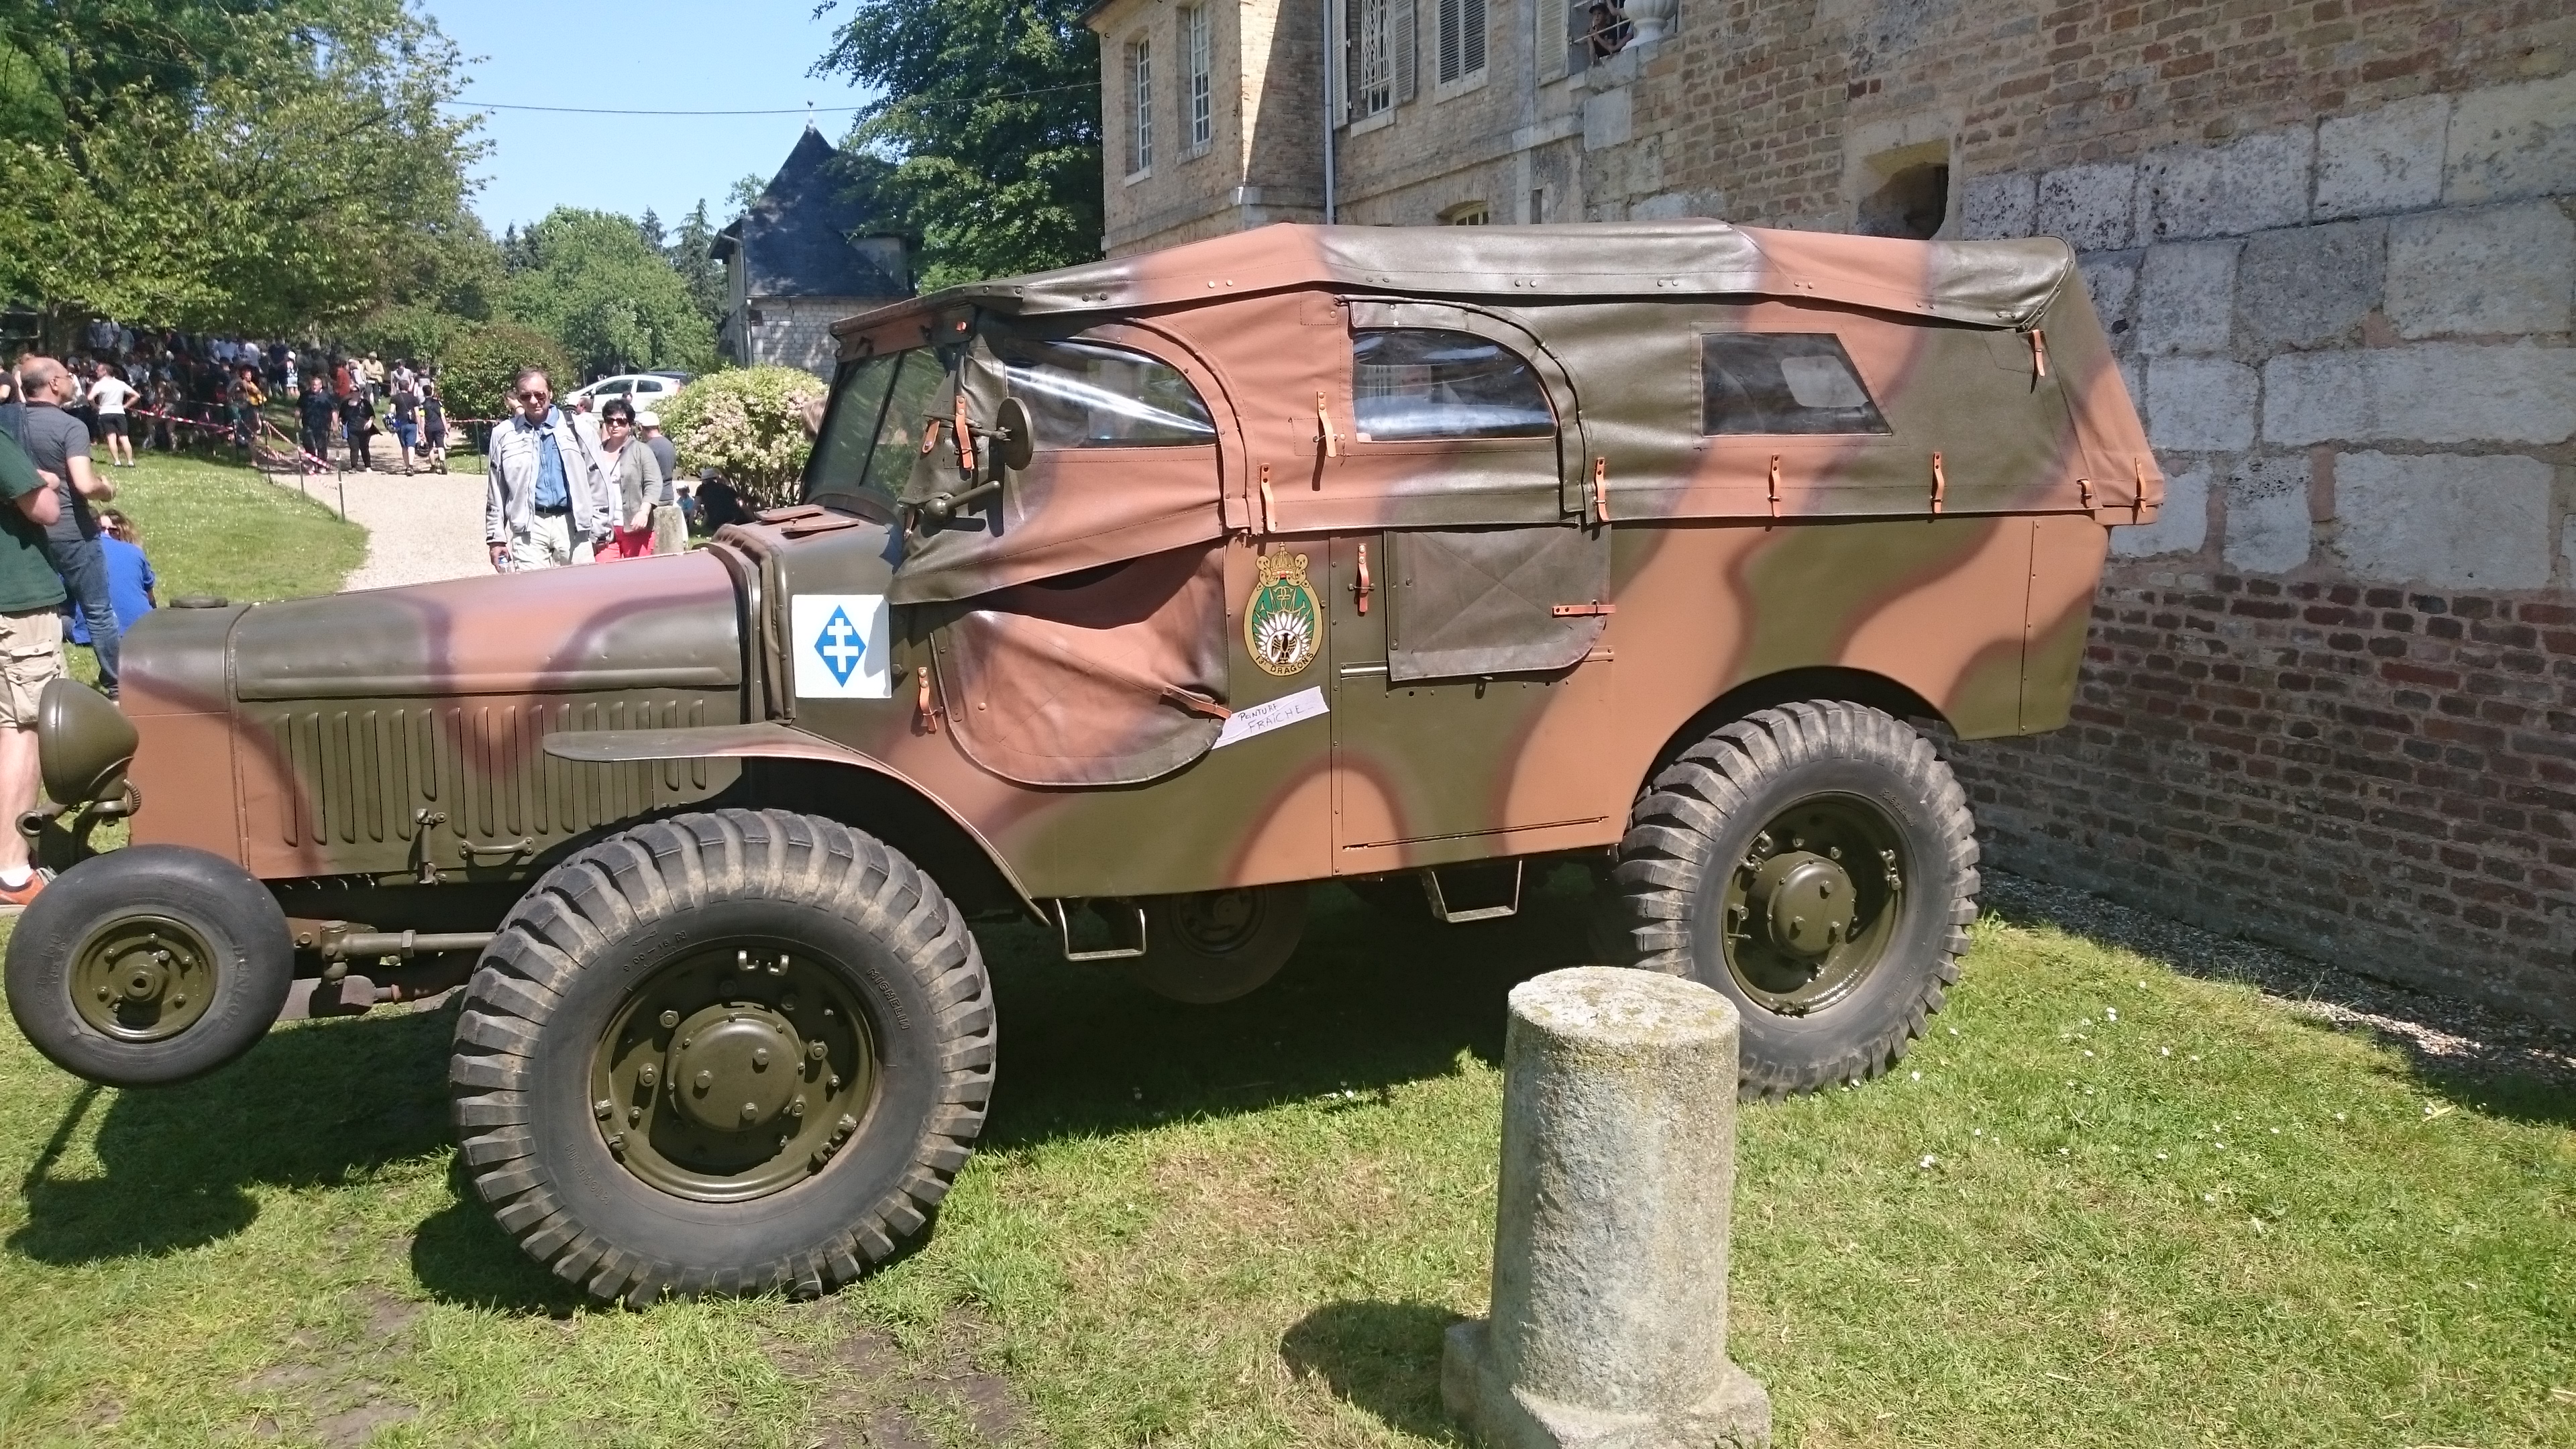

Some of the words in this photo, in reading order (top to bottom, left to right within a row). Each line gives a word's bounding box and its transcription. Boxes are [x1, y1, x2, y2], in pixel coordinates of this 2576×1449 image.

[1270, 652, 1314, 674] DRAGONS
[867, 967, 910, 1030] MICHELIN
[565, 1143, 612, 1206] MICHELIN
